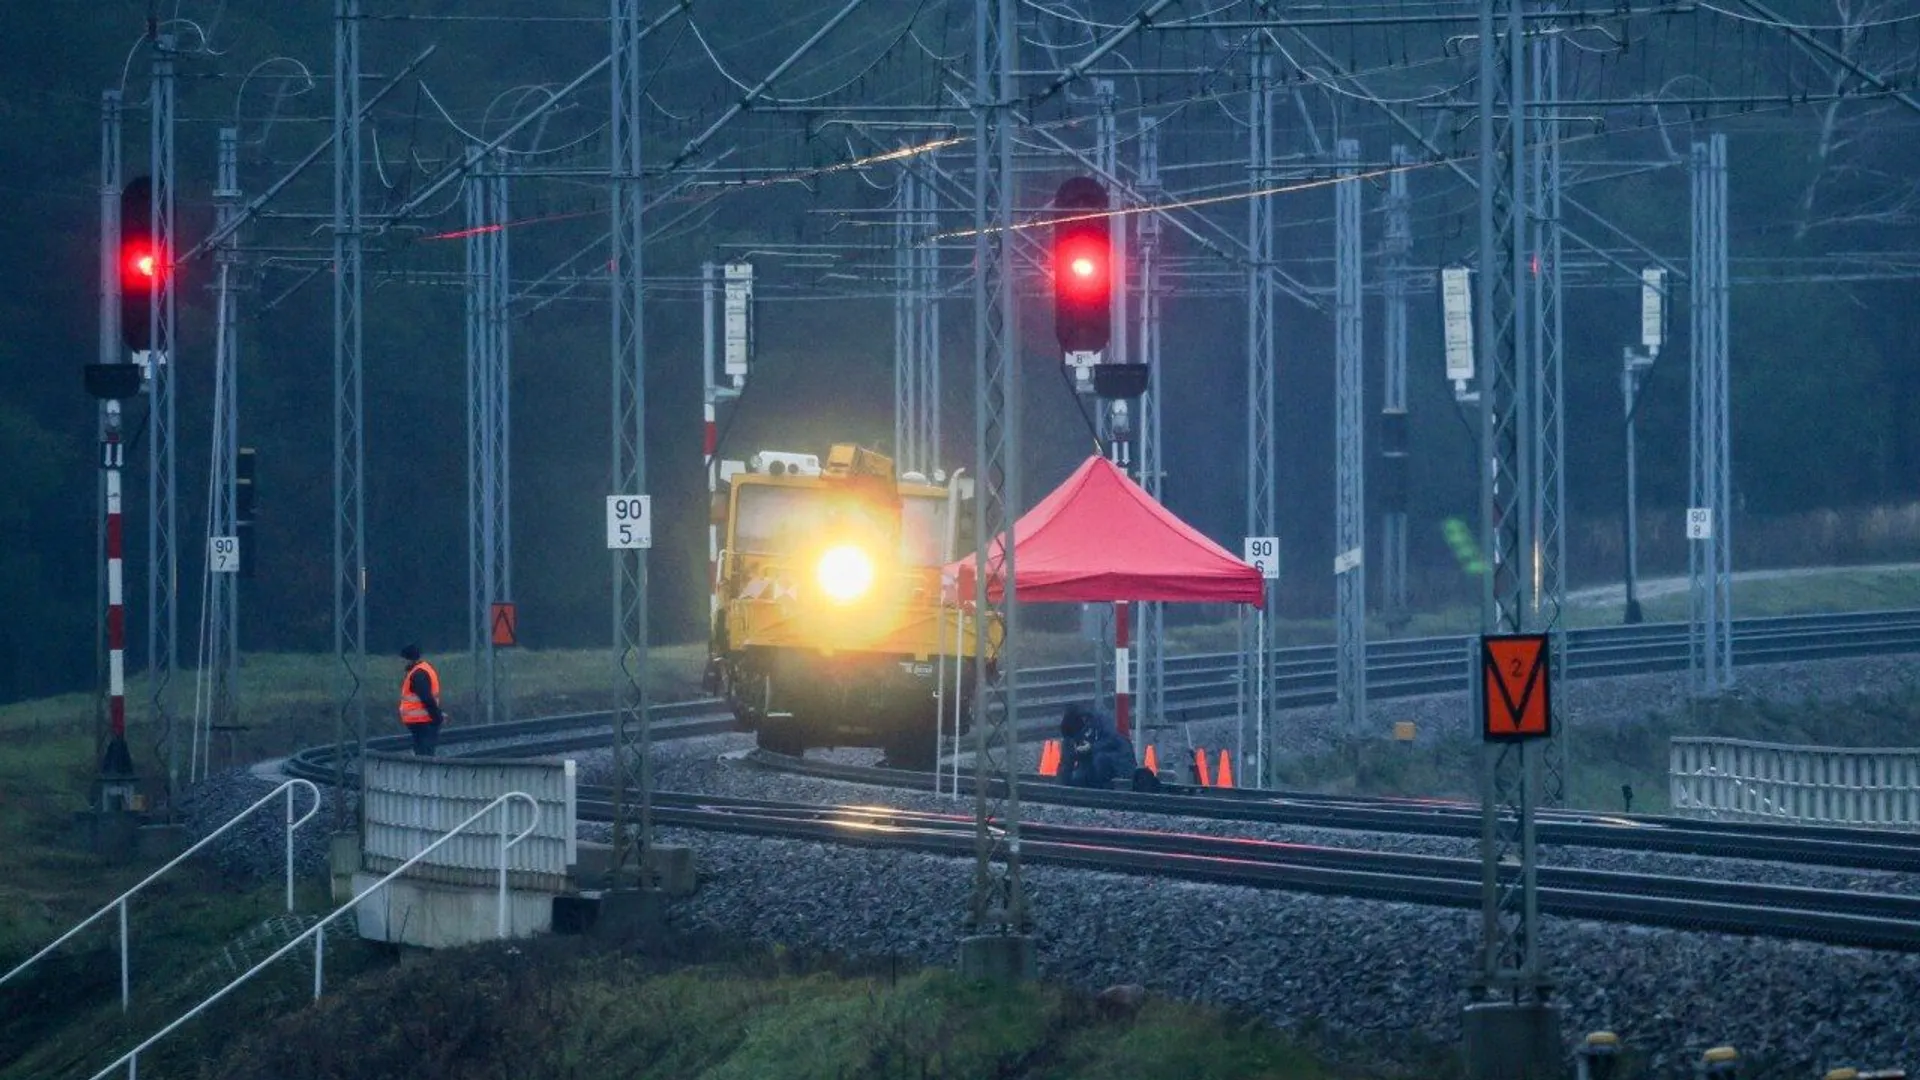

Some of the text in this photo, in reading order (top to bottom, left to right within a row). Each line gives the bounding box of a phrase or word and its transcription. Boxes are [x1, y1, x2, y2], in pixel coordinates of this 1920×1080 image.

[616, 499, 642, 520] 90
[619, 524, 632, 545] 5
[215, 539, 233, 553] 90
[1252, 541, 1272, 556] 90
[217, 555, 227, 569] 7
[1255, 560, 1265, 574] 6
[1511, 658, 1523, 678] 2
